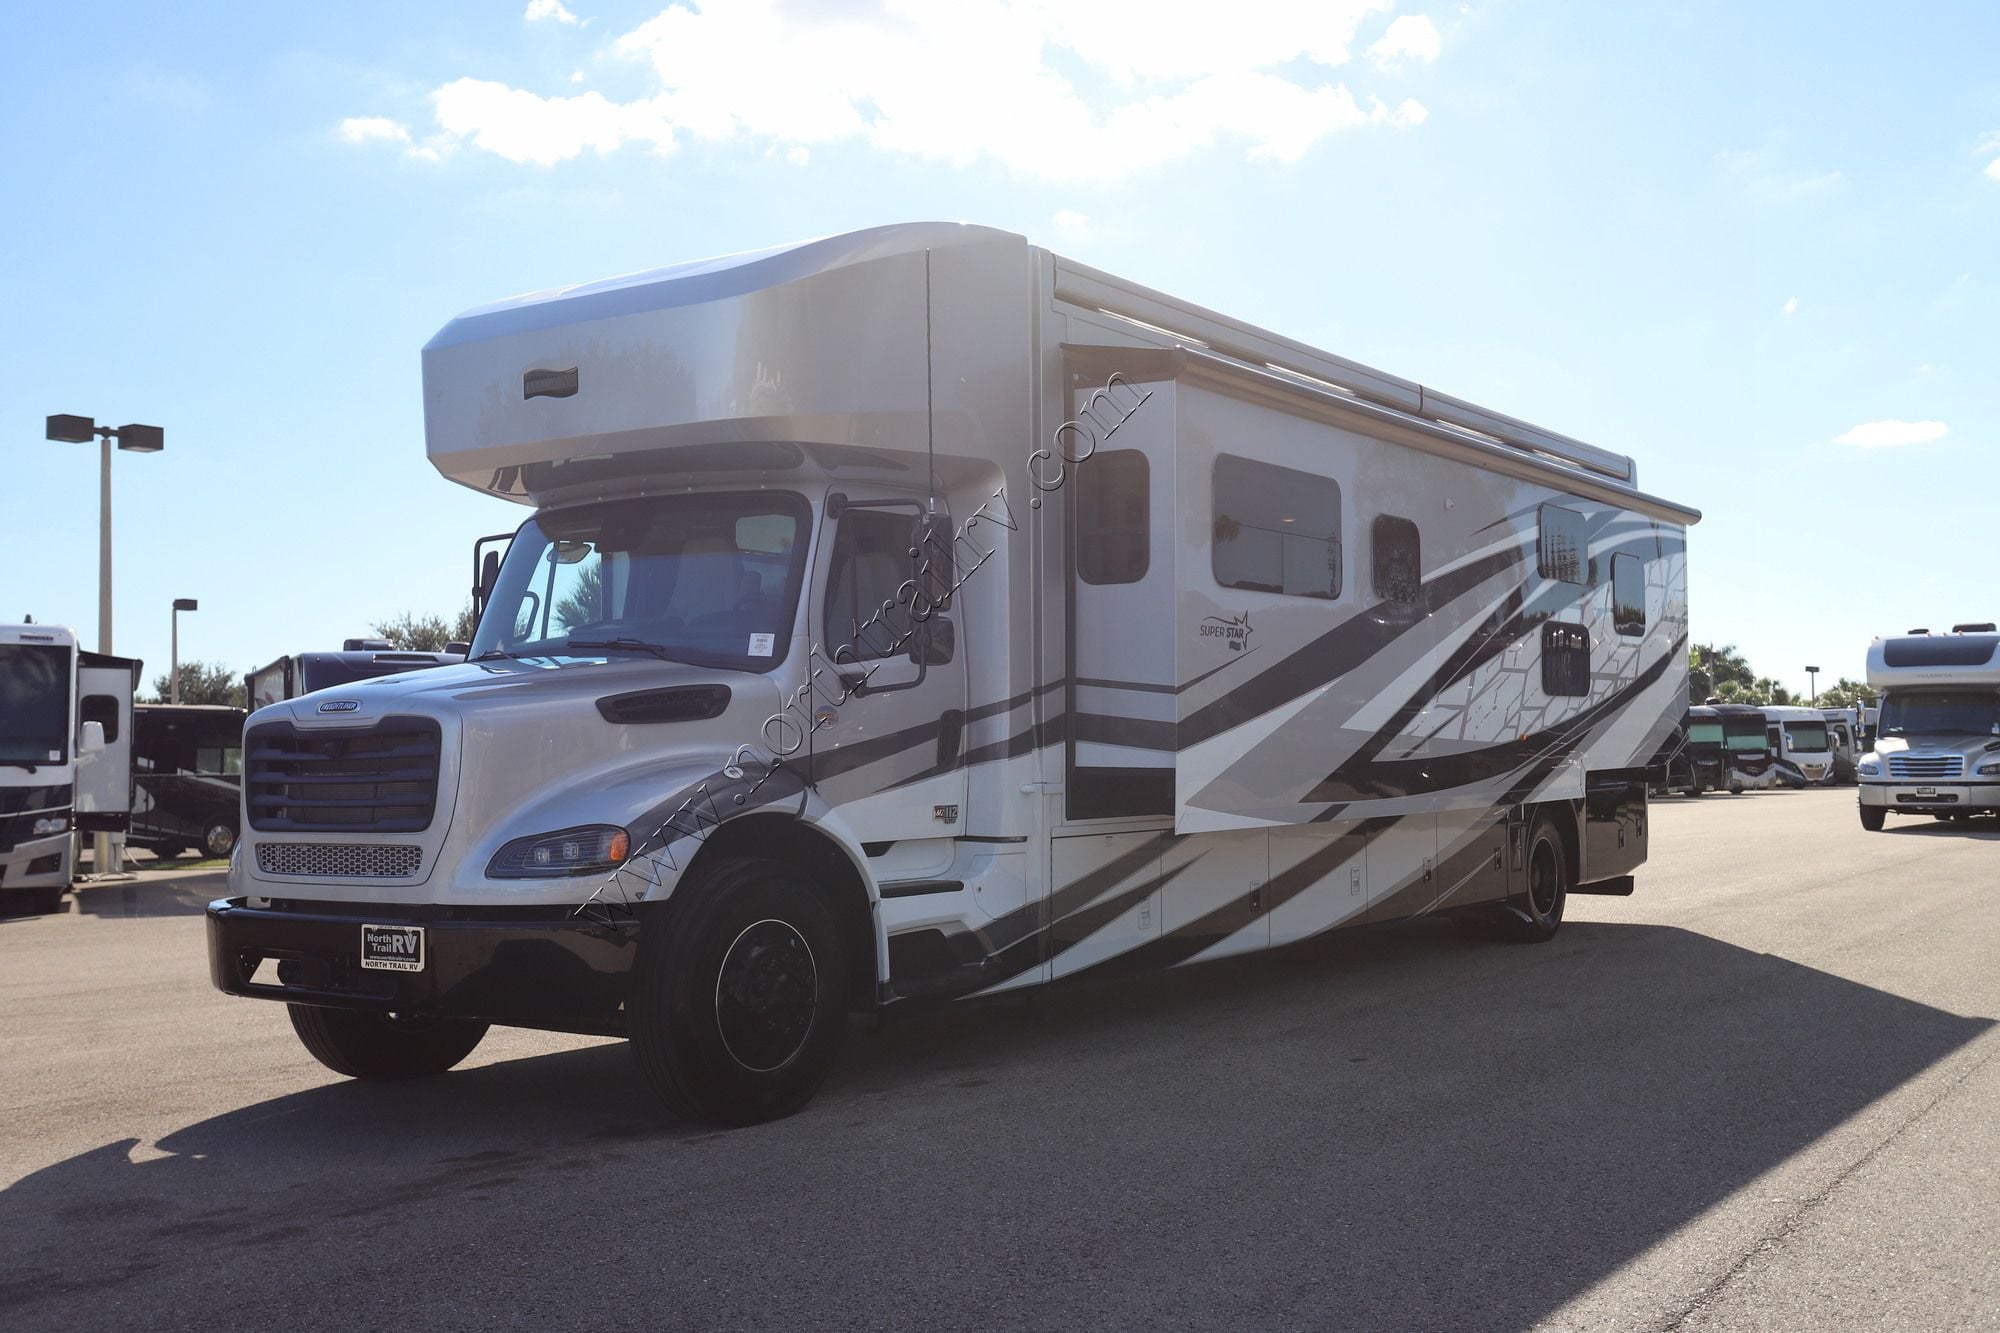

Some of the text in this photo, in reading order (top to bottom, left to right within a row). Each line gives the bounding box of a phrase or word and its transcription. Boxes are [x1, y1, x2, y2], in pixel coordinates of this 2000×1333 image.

[1200, 625, 1244, 639] SUPER STAR
[368, 933, 392, 943] North
[392, 934, 417, 953] RV
[372, 943, 392, 952] Trail
